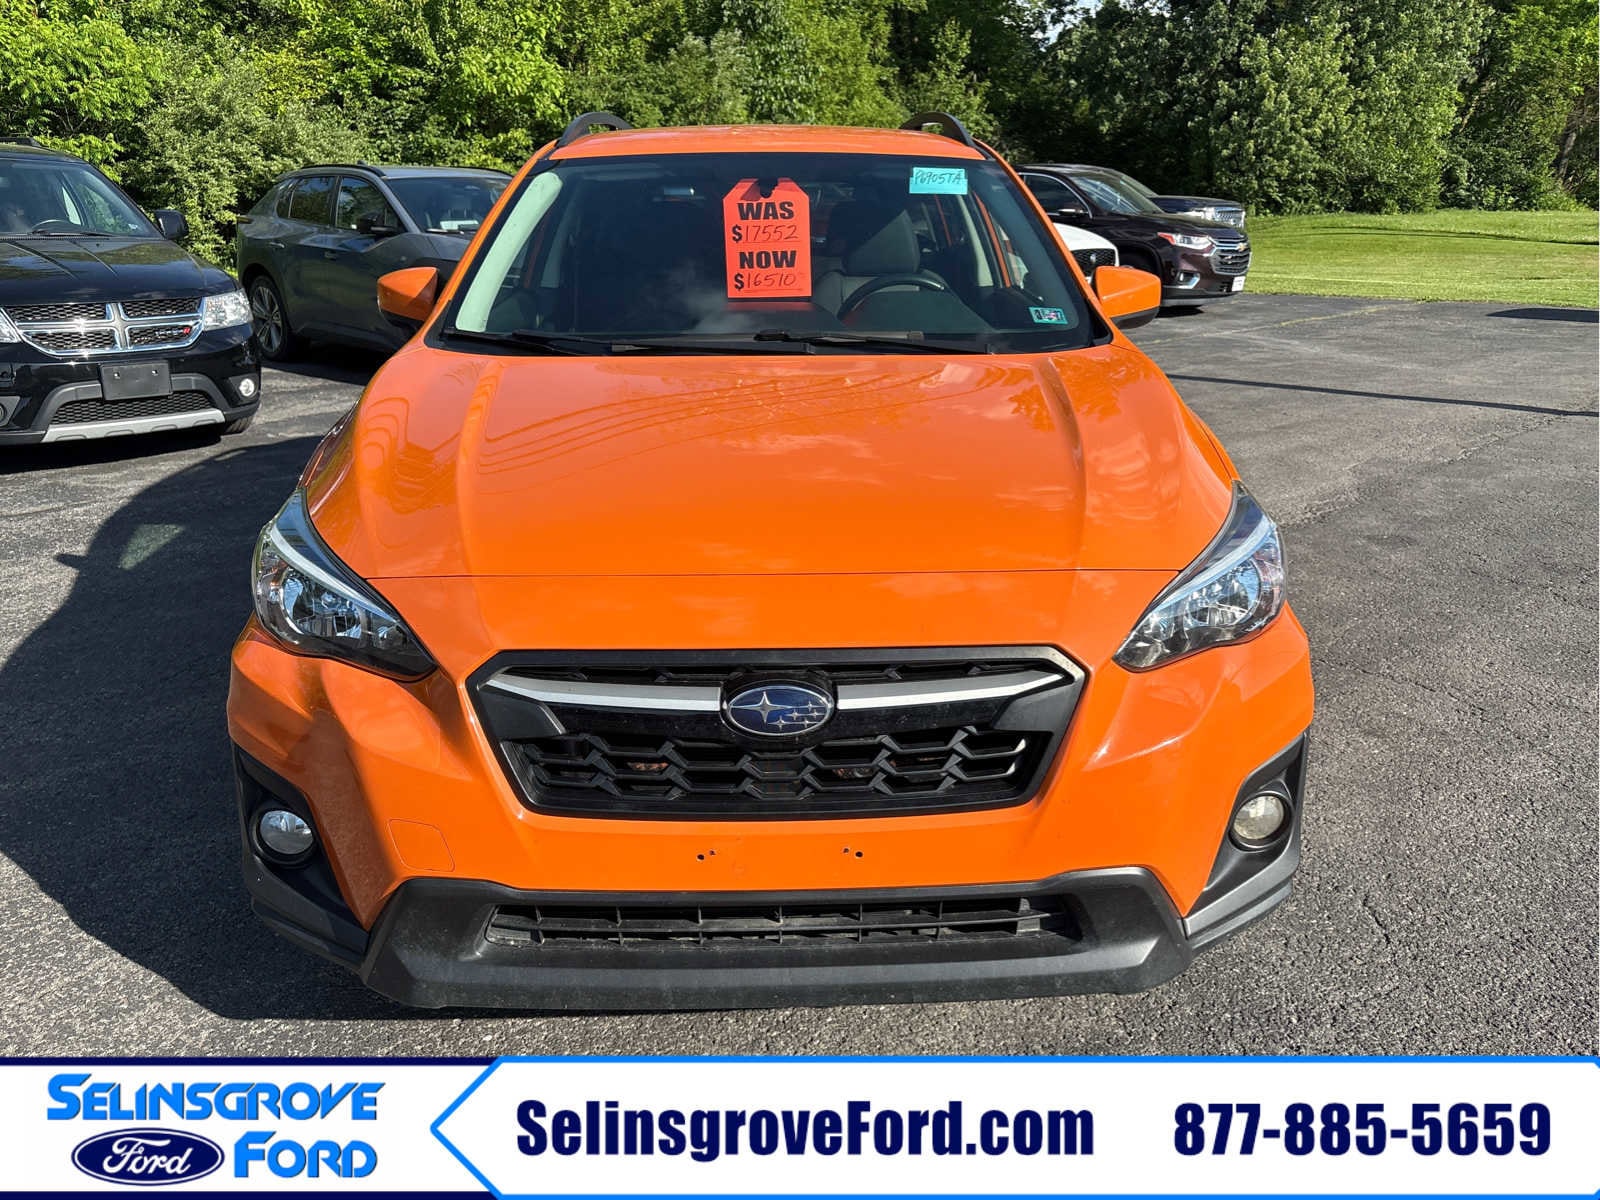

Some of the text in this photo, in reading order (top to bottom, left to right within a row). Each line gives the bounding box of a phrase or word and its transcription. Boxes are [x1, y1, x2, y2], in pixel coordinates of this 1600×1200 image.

[737, 201, 794, 221] WAS
[731, 224, 799, 243] $17552
[739, 250, 797, 269] NOW
